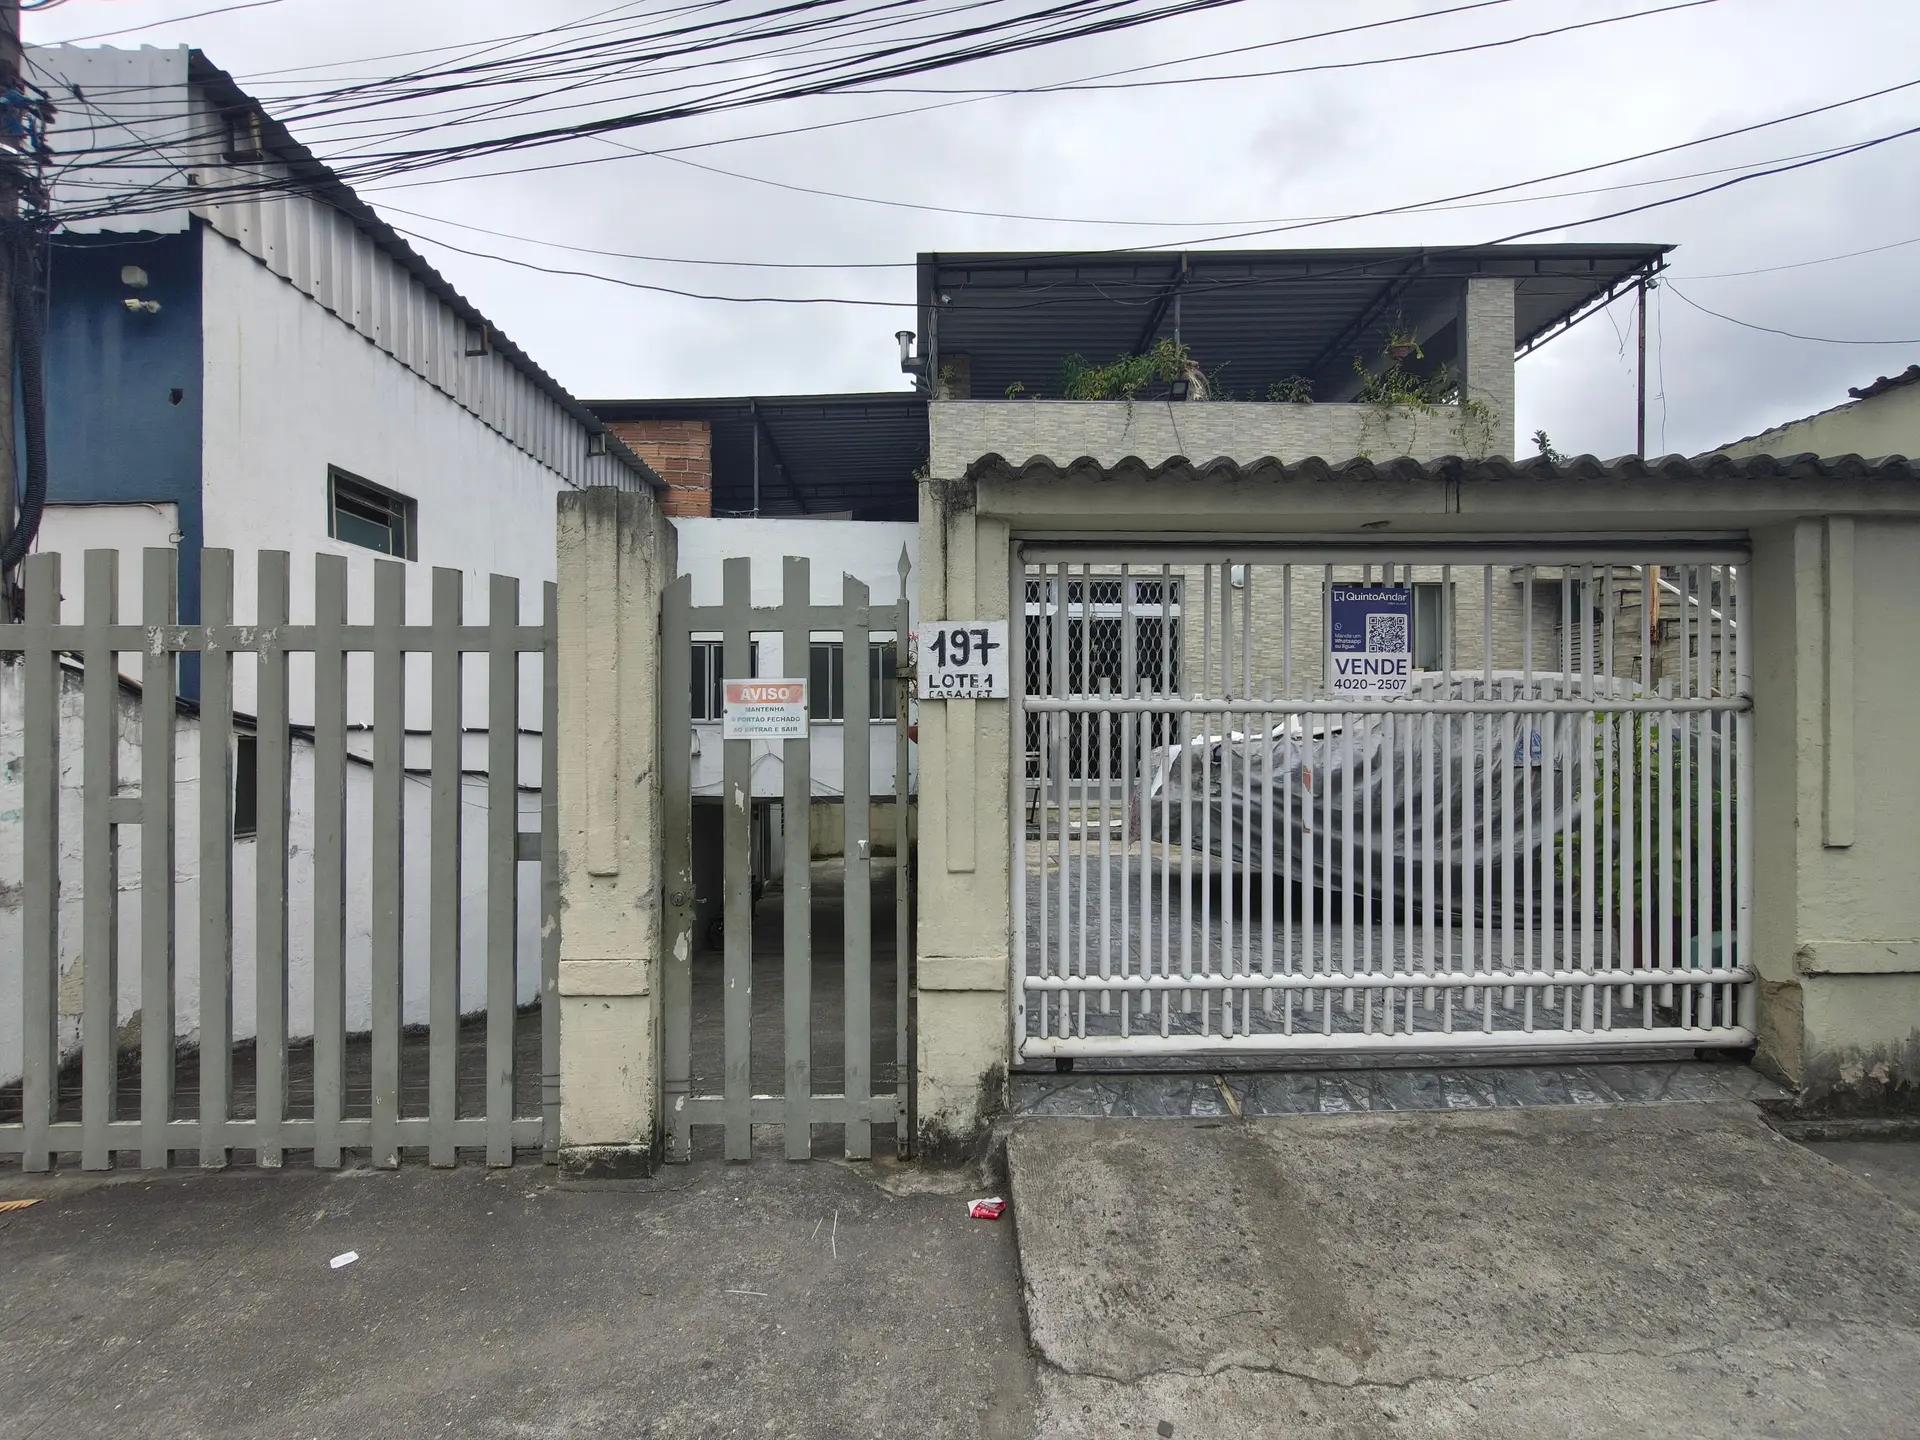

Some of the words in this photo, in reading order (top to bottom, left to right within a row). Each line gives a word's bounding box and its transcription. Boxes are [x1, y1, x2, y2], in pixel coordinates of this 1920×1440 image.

[1346, 591, 1407, 602] QuintoAndar
[928, 628, 1000, 668] 197
[1335, 658, 1407, 675] VENDE
[1334, 678, 1407, 690] 4020-2507
[740, 687, 790, 702] AVISO
